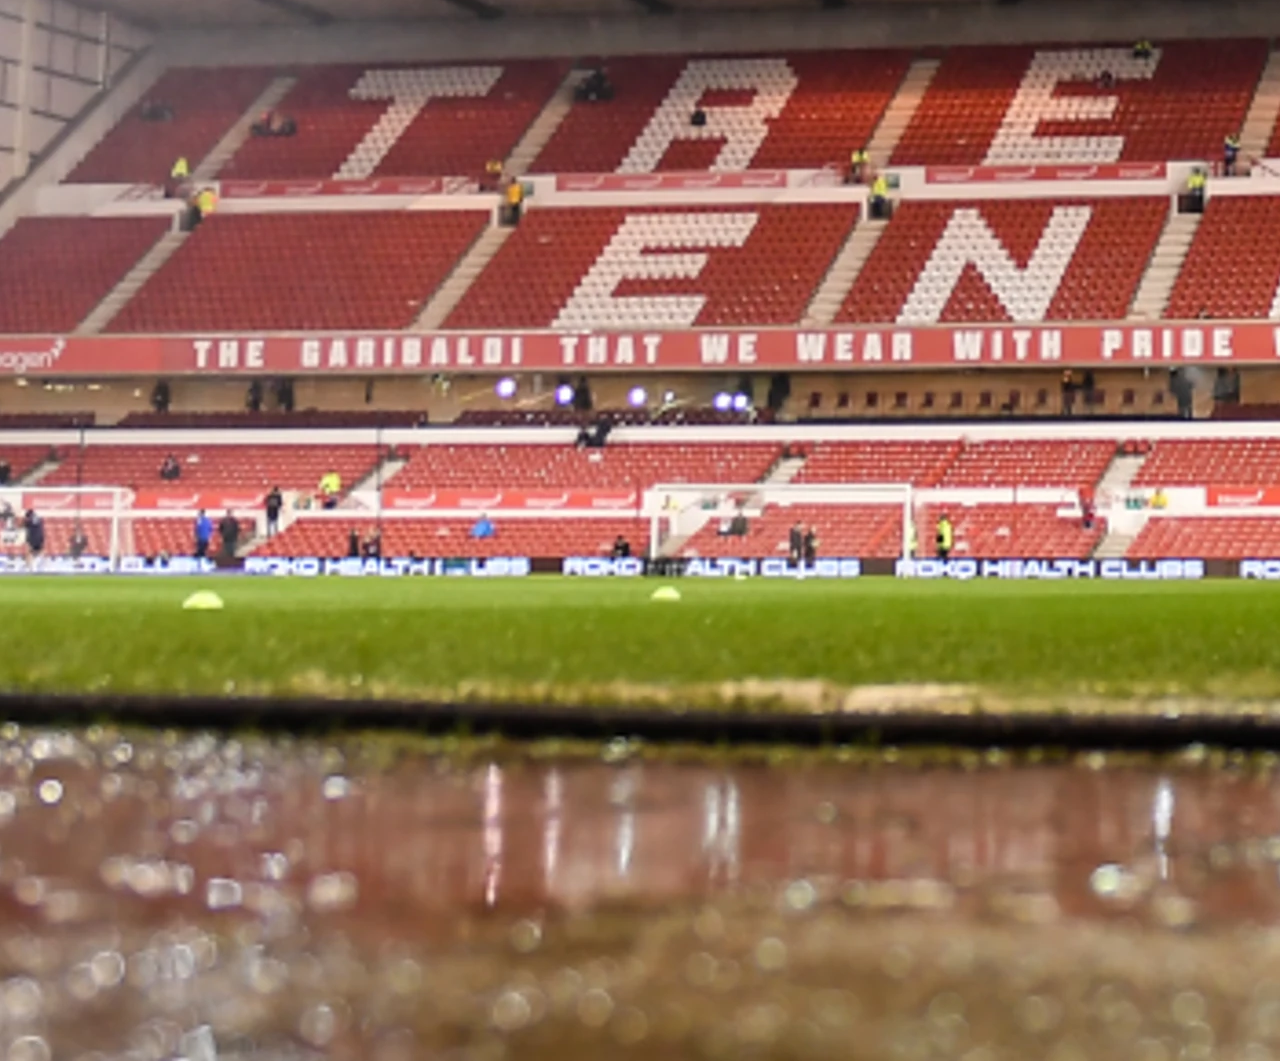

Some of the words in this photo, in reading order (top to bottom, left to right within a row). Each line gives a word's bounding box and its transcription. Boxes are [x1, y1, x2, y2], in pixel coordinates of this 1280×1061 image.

[193, 340, 264, 368] THE
[301, 337, 522, 367] GARIBALDI
[559, 335, 662, 364] THAT
[699, 333, 758, 364] WE
[795, 332, 913, 363] WEAR
[952, 329, 1062, 361] WITH
[1101, 327, 1233, 358] PRIDE
[244, 557, 319, 576] ROKO
[325, 557, 430, 576] HEALTH
[562, 558, 643, 576] ROKO
[683, 558, 757, 577] ALTH
[760, 558, 861, 577] CLUBS
[895, 558, 979, 579] ROKO
[982, 559, 1096, 579] HEALTH
[1100, 559, 1204, 579] CLUBS
